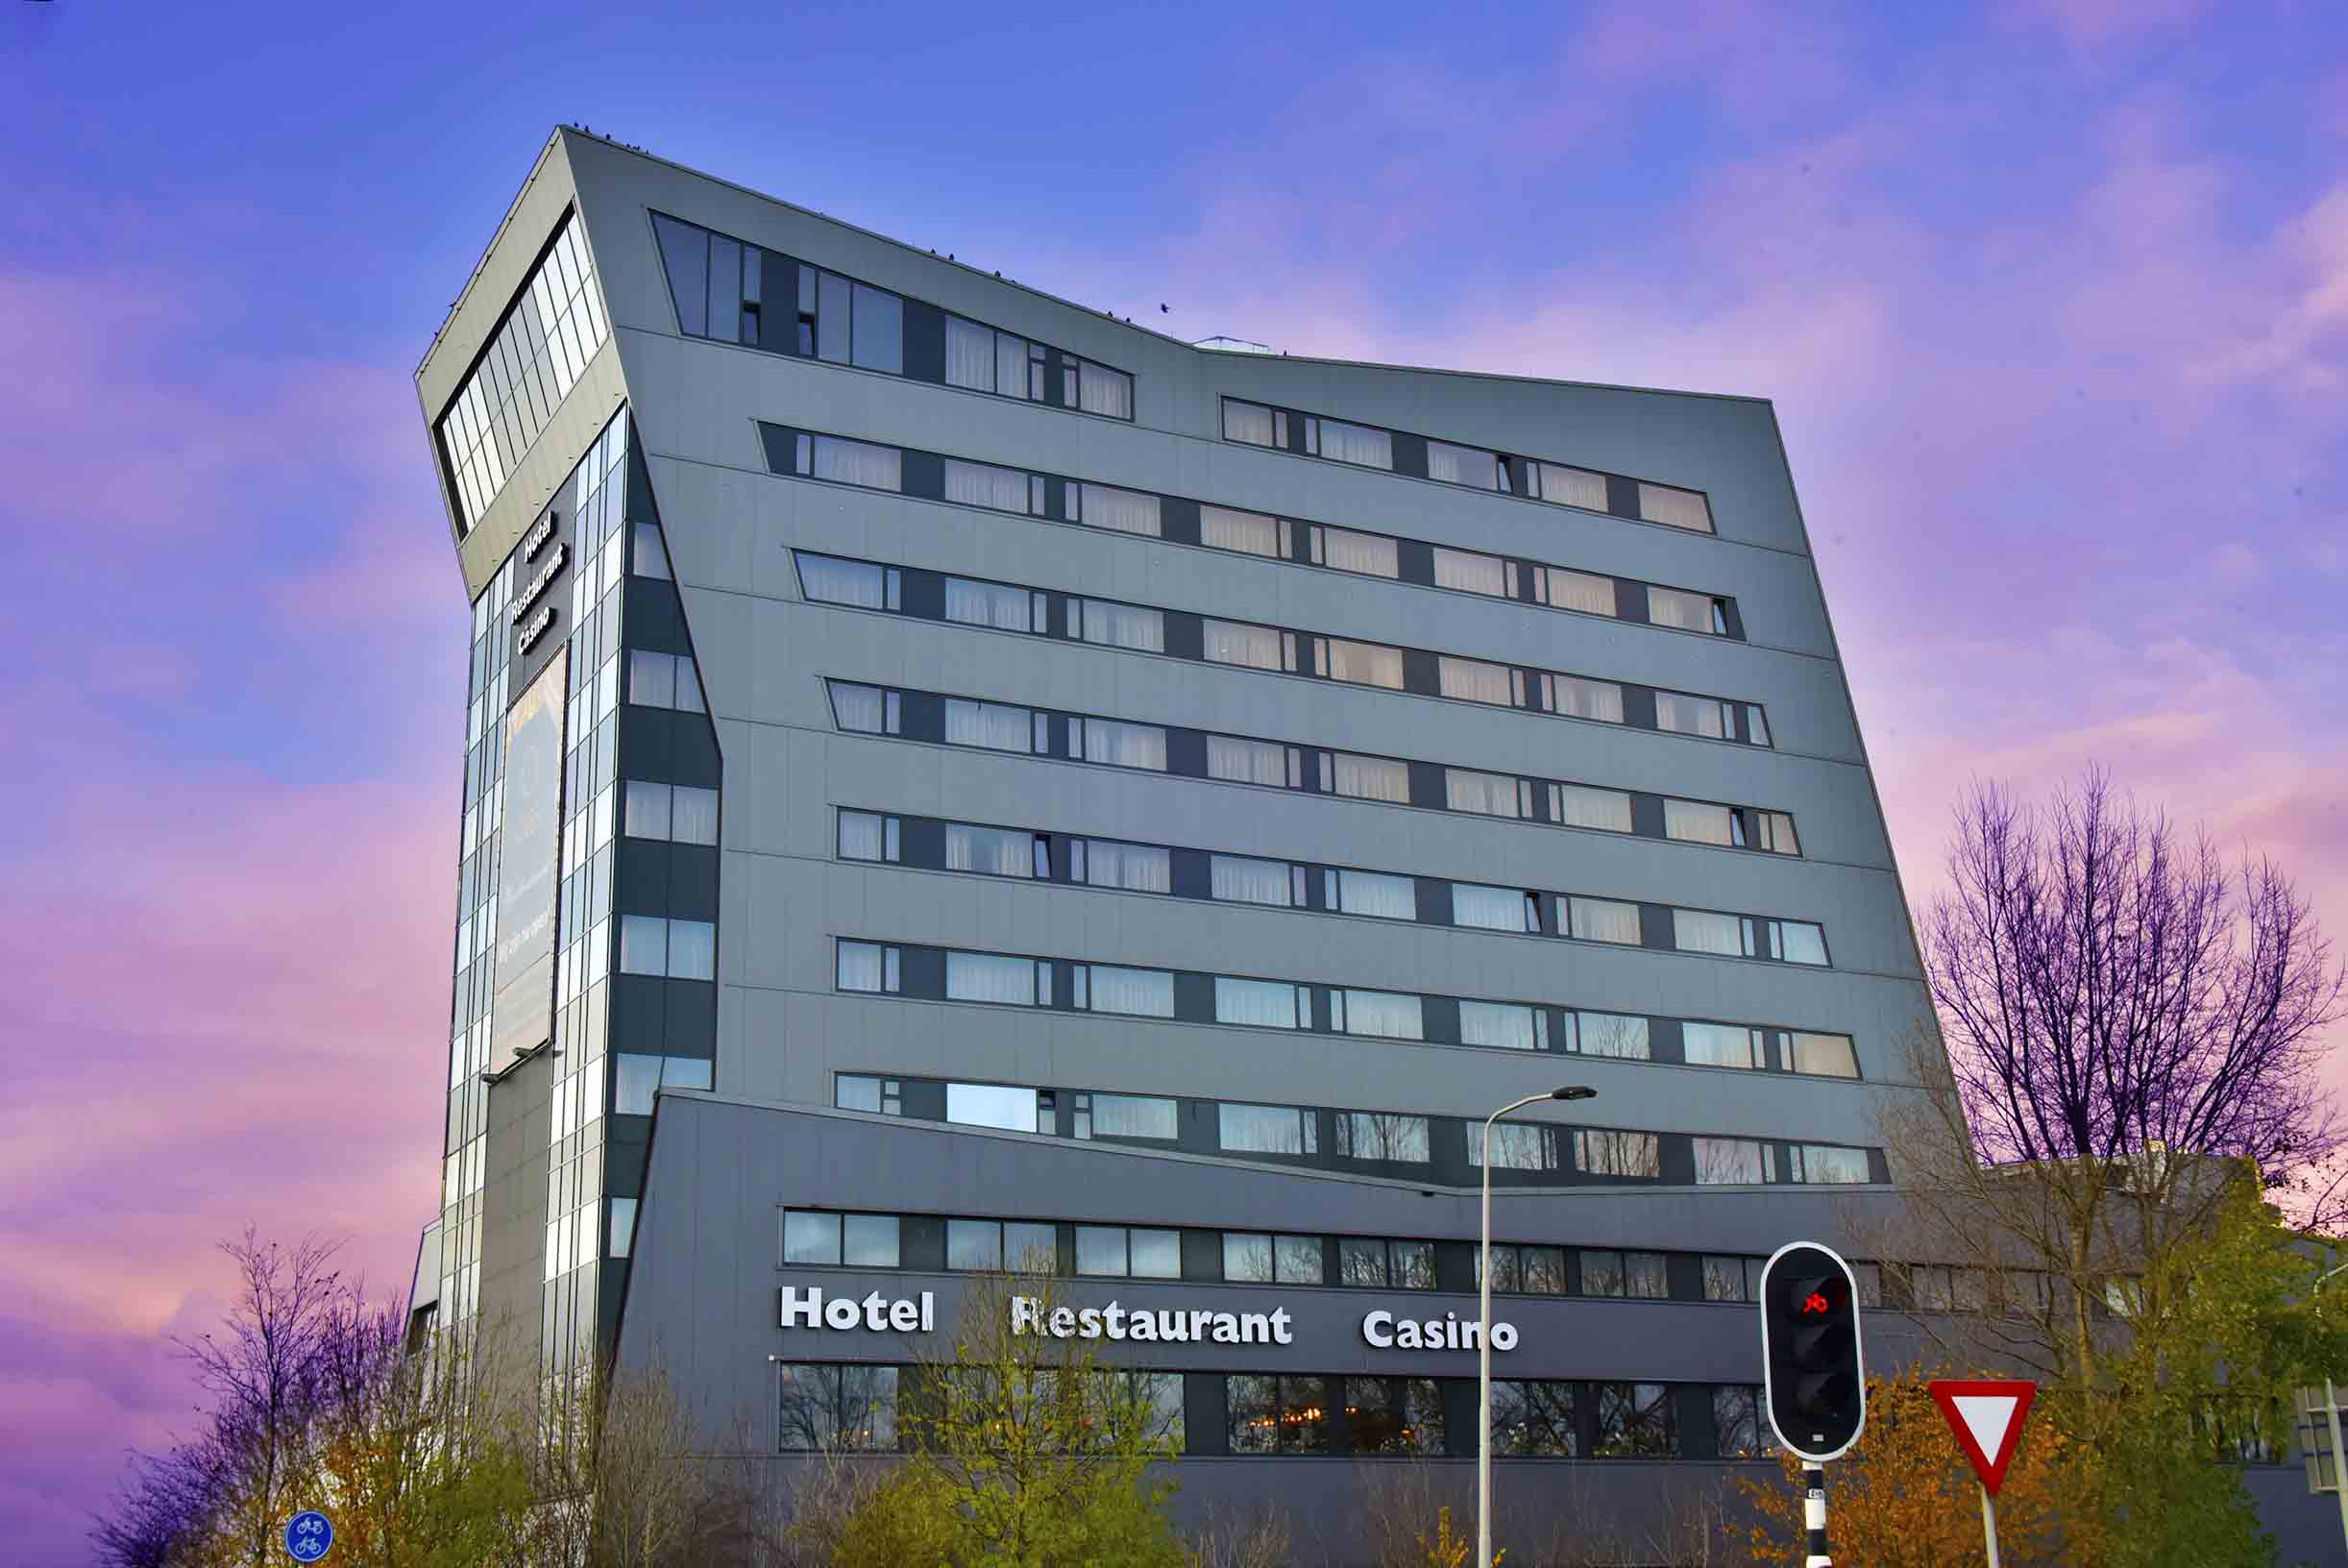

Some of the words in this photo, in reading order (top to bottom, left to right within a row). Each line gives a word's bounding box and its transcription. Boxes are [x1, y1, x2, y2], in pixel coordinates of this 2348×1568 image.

[524, 510, 553, 563] Hotel
[511, 542, 565, 625] Restaurant
[518, 605, 550, 655] Casino
[780, 1286, 934, 1332] Hotel
[1012, 1295, 1292, 1344] Restaurant
[1362, 1310, 1519, 1351] Casino
